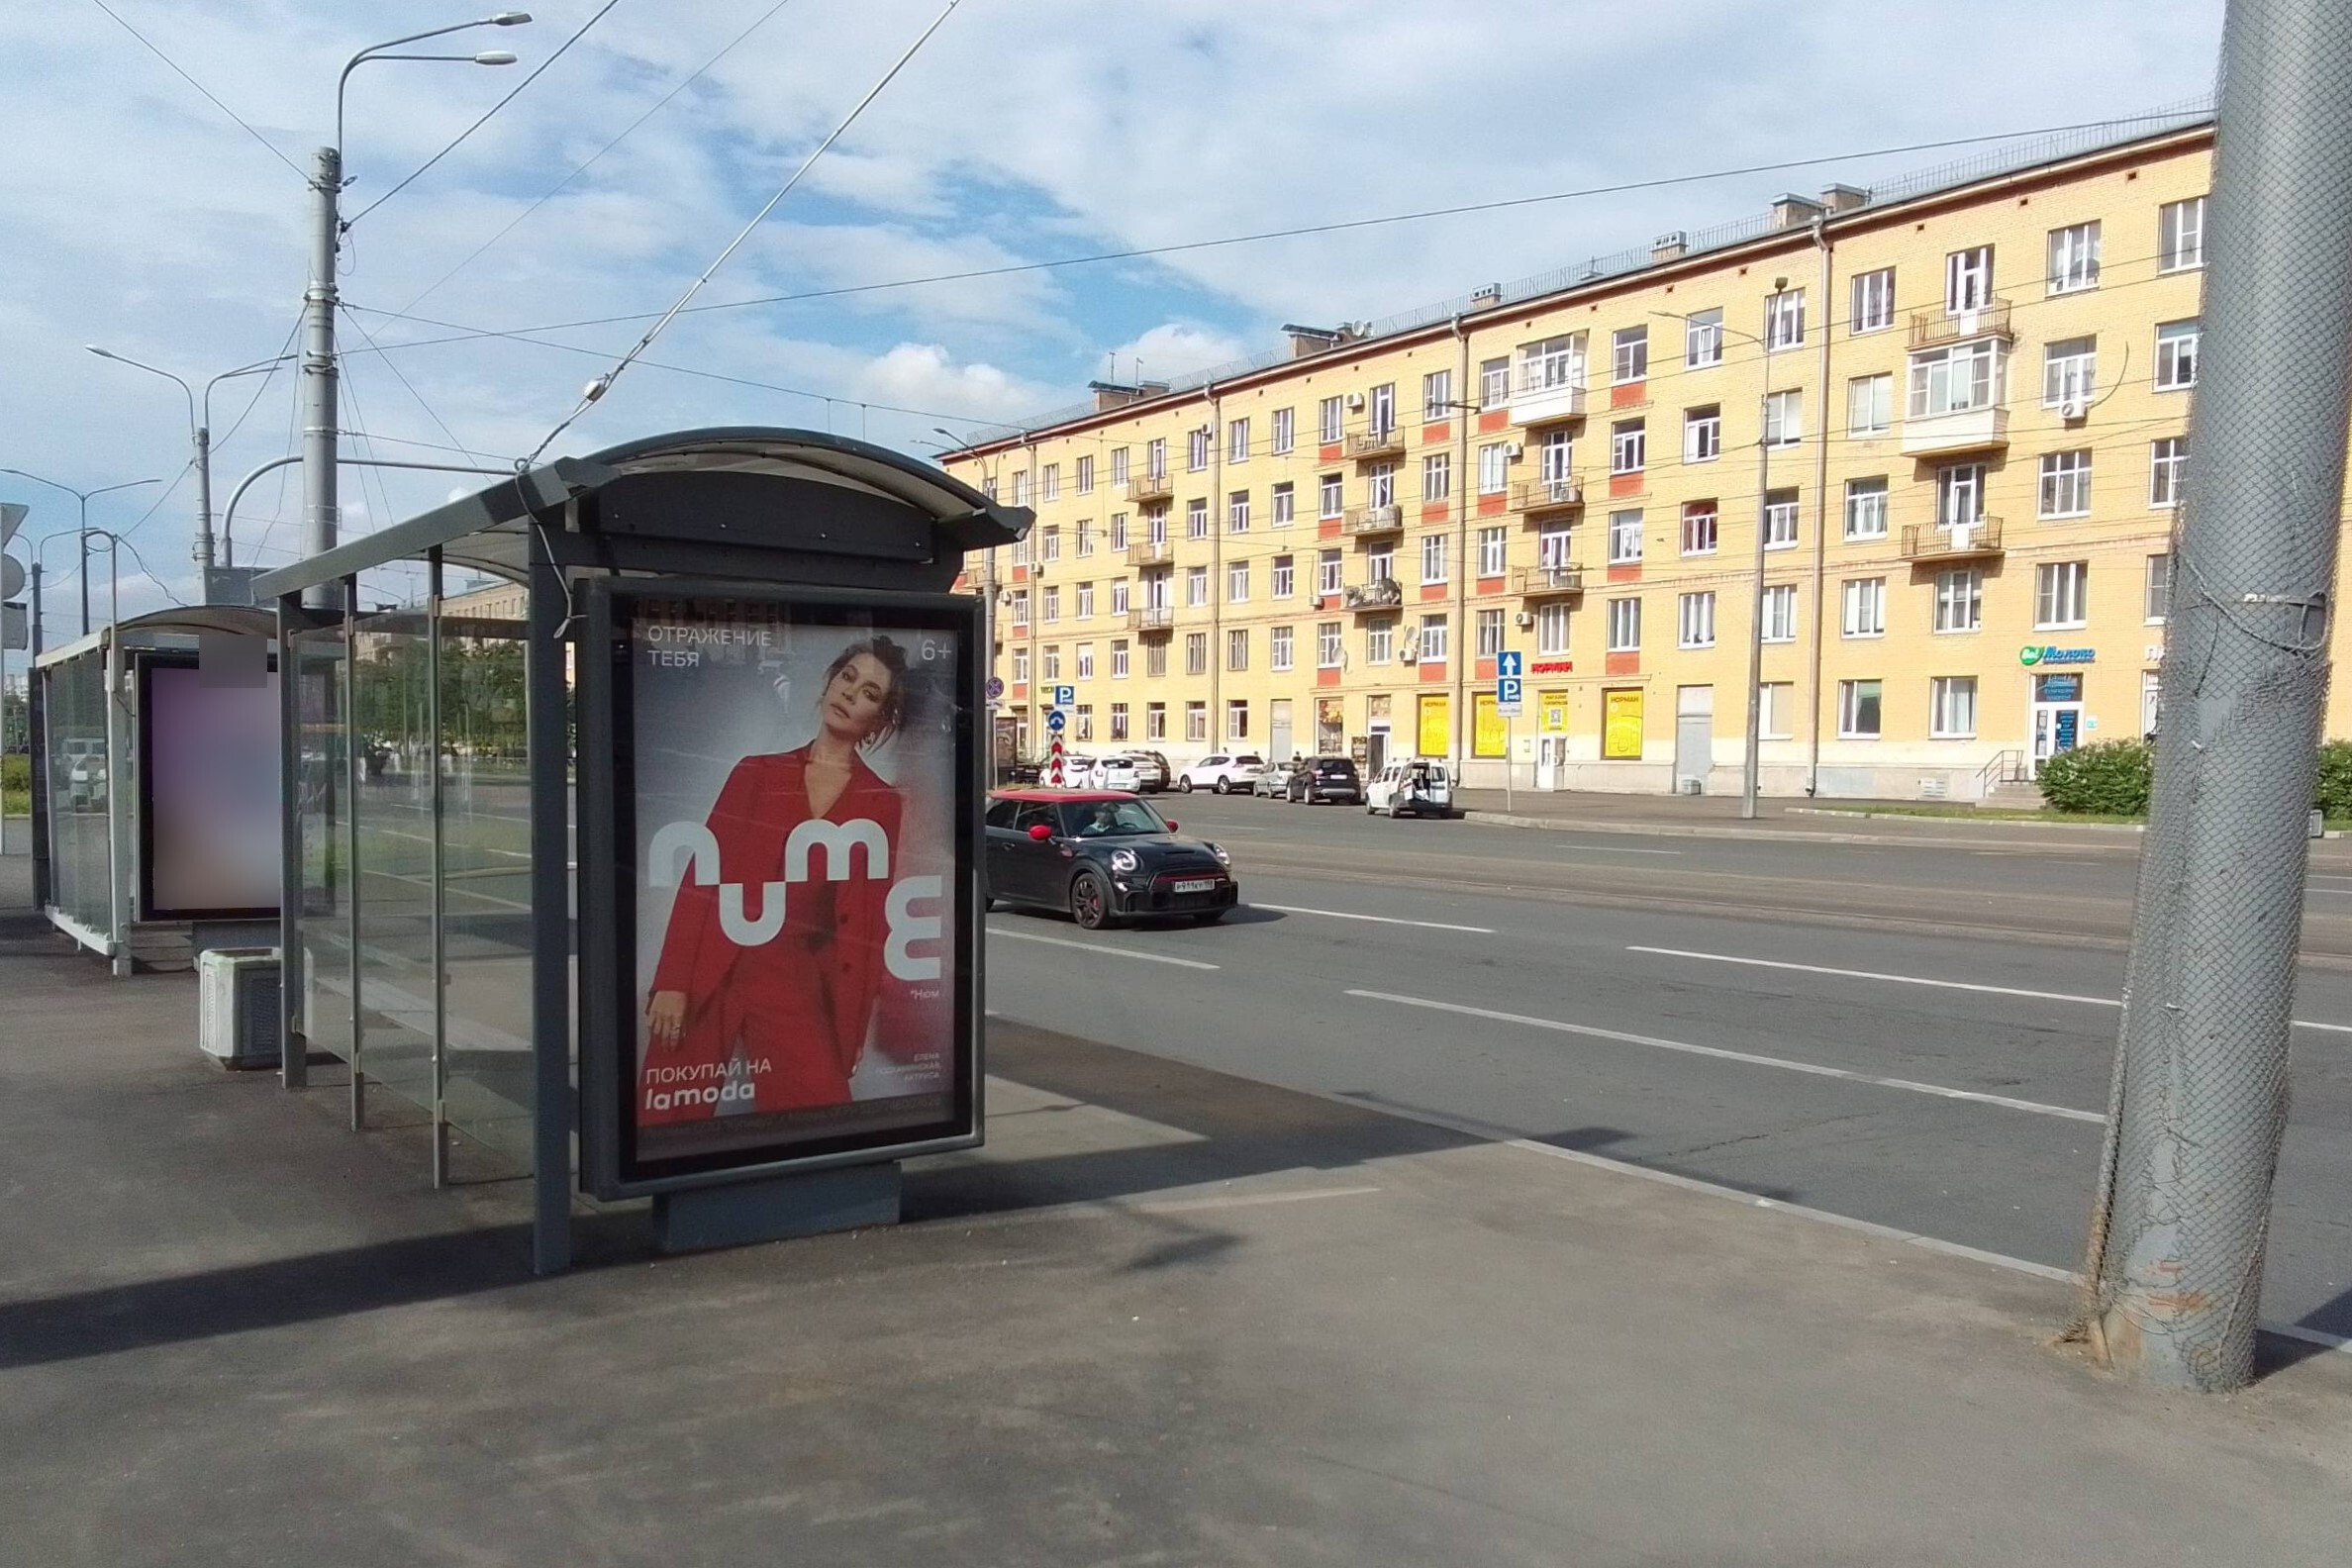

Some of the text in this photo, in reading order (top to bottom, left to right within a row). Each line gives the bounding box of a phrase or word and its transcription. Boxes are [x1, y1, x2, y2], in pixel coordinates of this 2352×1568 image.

[647, 626, 772, 646] ОТРАЖЕНИЕ
[646, 649, 700, 667] ТЕБЯ
[921, 638, 952, 661] 6+
[645, 1057, 772, 1085] ПОКУПАЙ НА
[645, 1080, 755, 1110] lamoda
